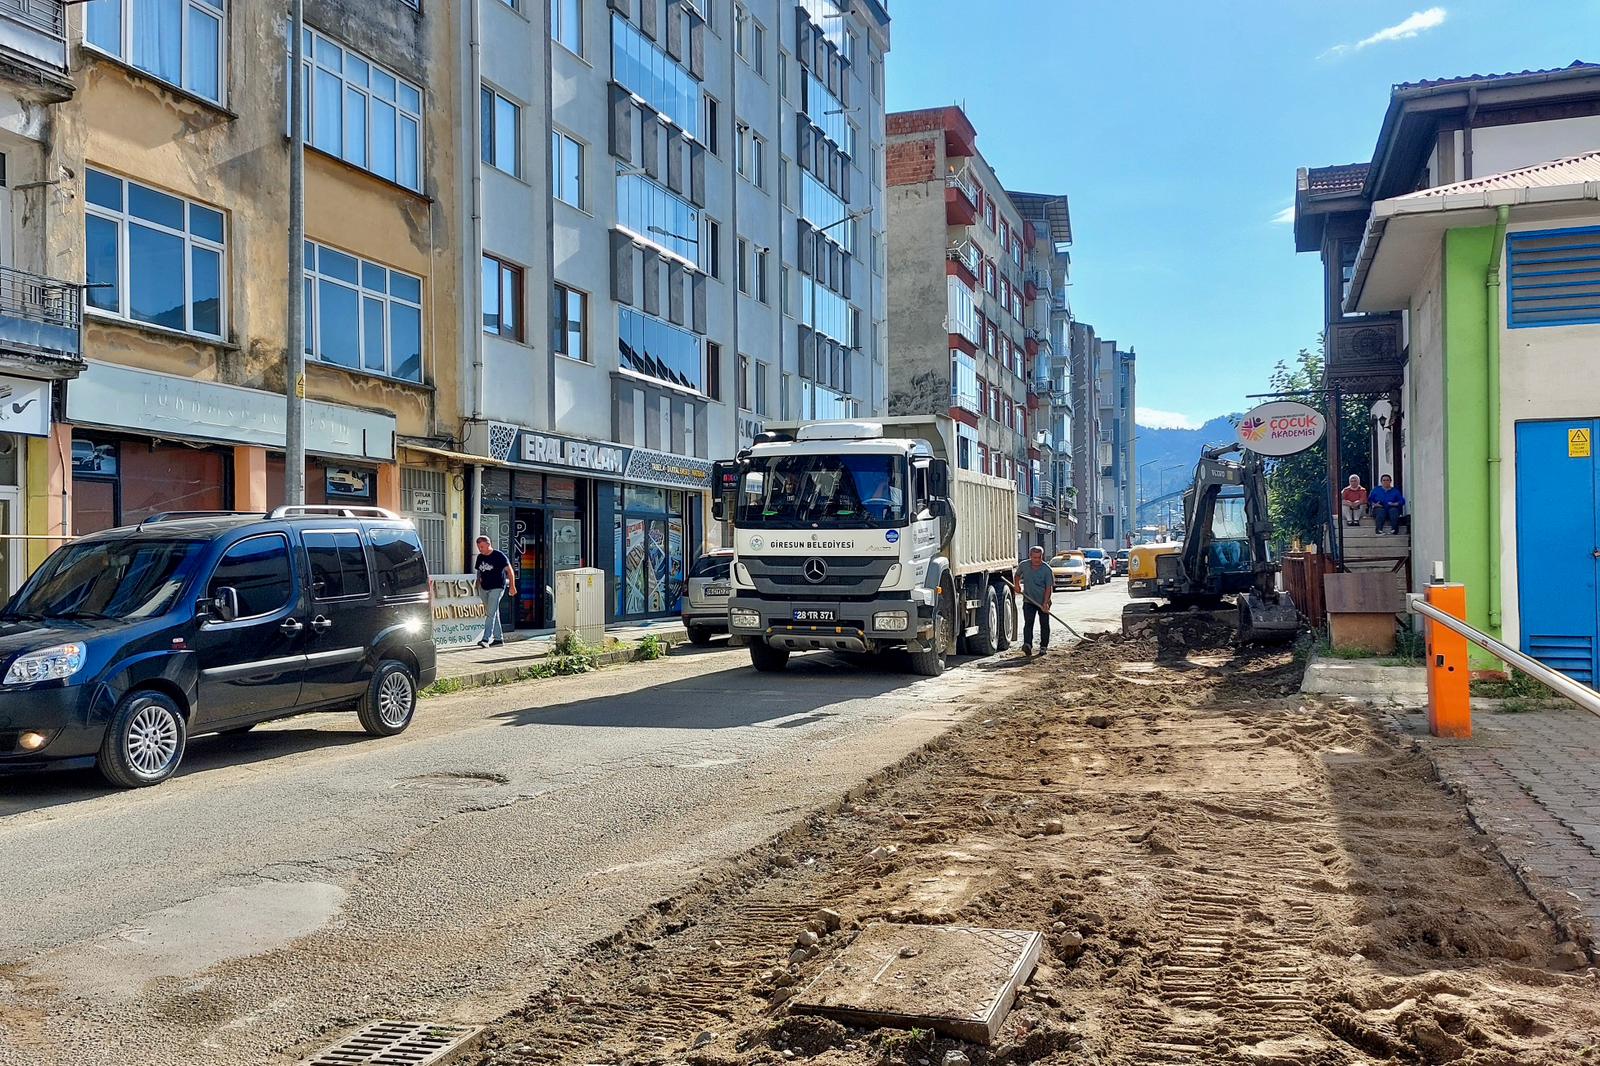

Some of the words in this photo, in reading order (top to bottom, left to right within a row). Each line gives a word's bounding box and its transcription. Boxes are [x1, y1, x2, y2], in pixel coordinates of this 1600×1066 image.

[1270, 415, 1317, 430] ÇOCUK
[1271, 428, 1316, 439] AKADEMİSİ
[521, 433, 565, 465] ERAL
[564, 440, 623, 473] REKLAM
[770, 541, 805, 549] GİRESUN
[807, 541, 855, 549] BELEDİYESİ
[453, 603, 487, 619] TOSUNO
[797, 611, 806, 619] 28
[807, 611, 819, 619] TR
[820, 611, 834, 620] 371
[442, 624, 459, 635] Diyet
